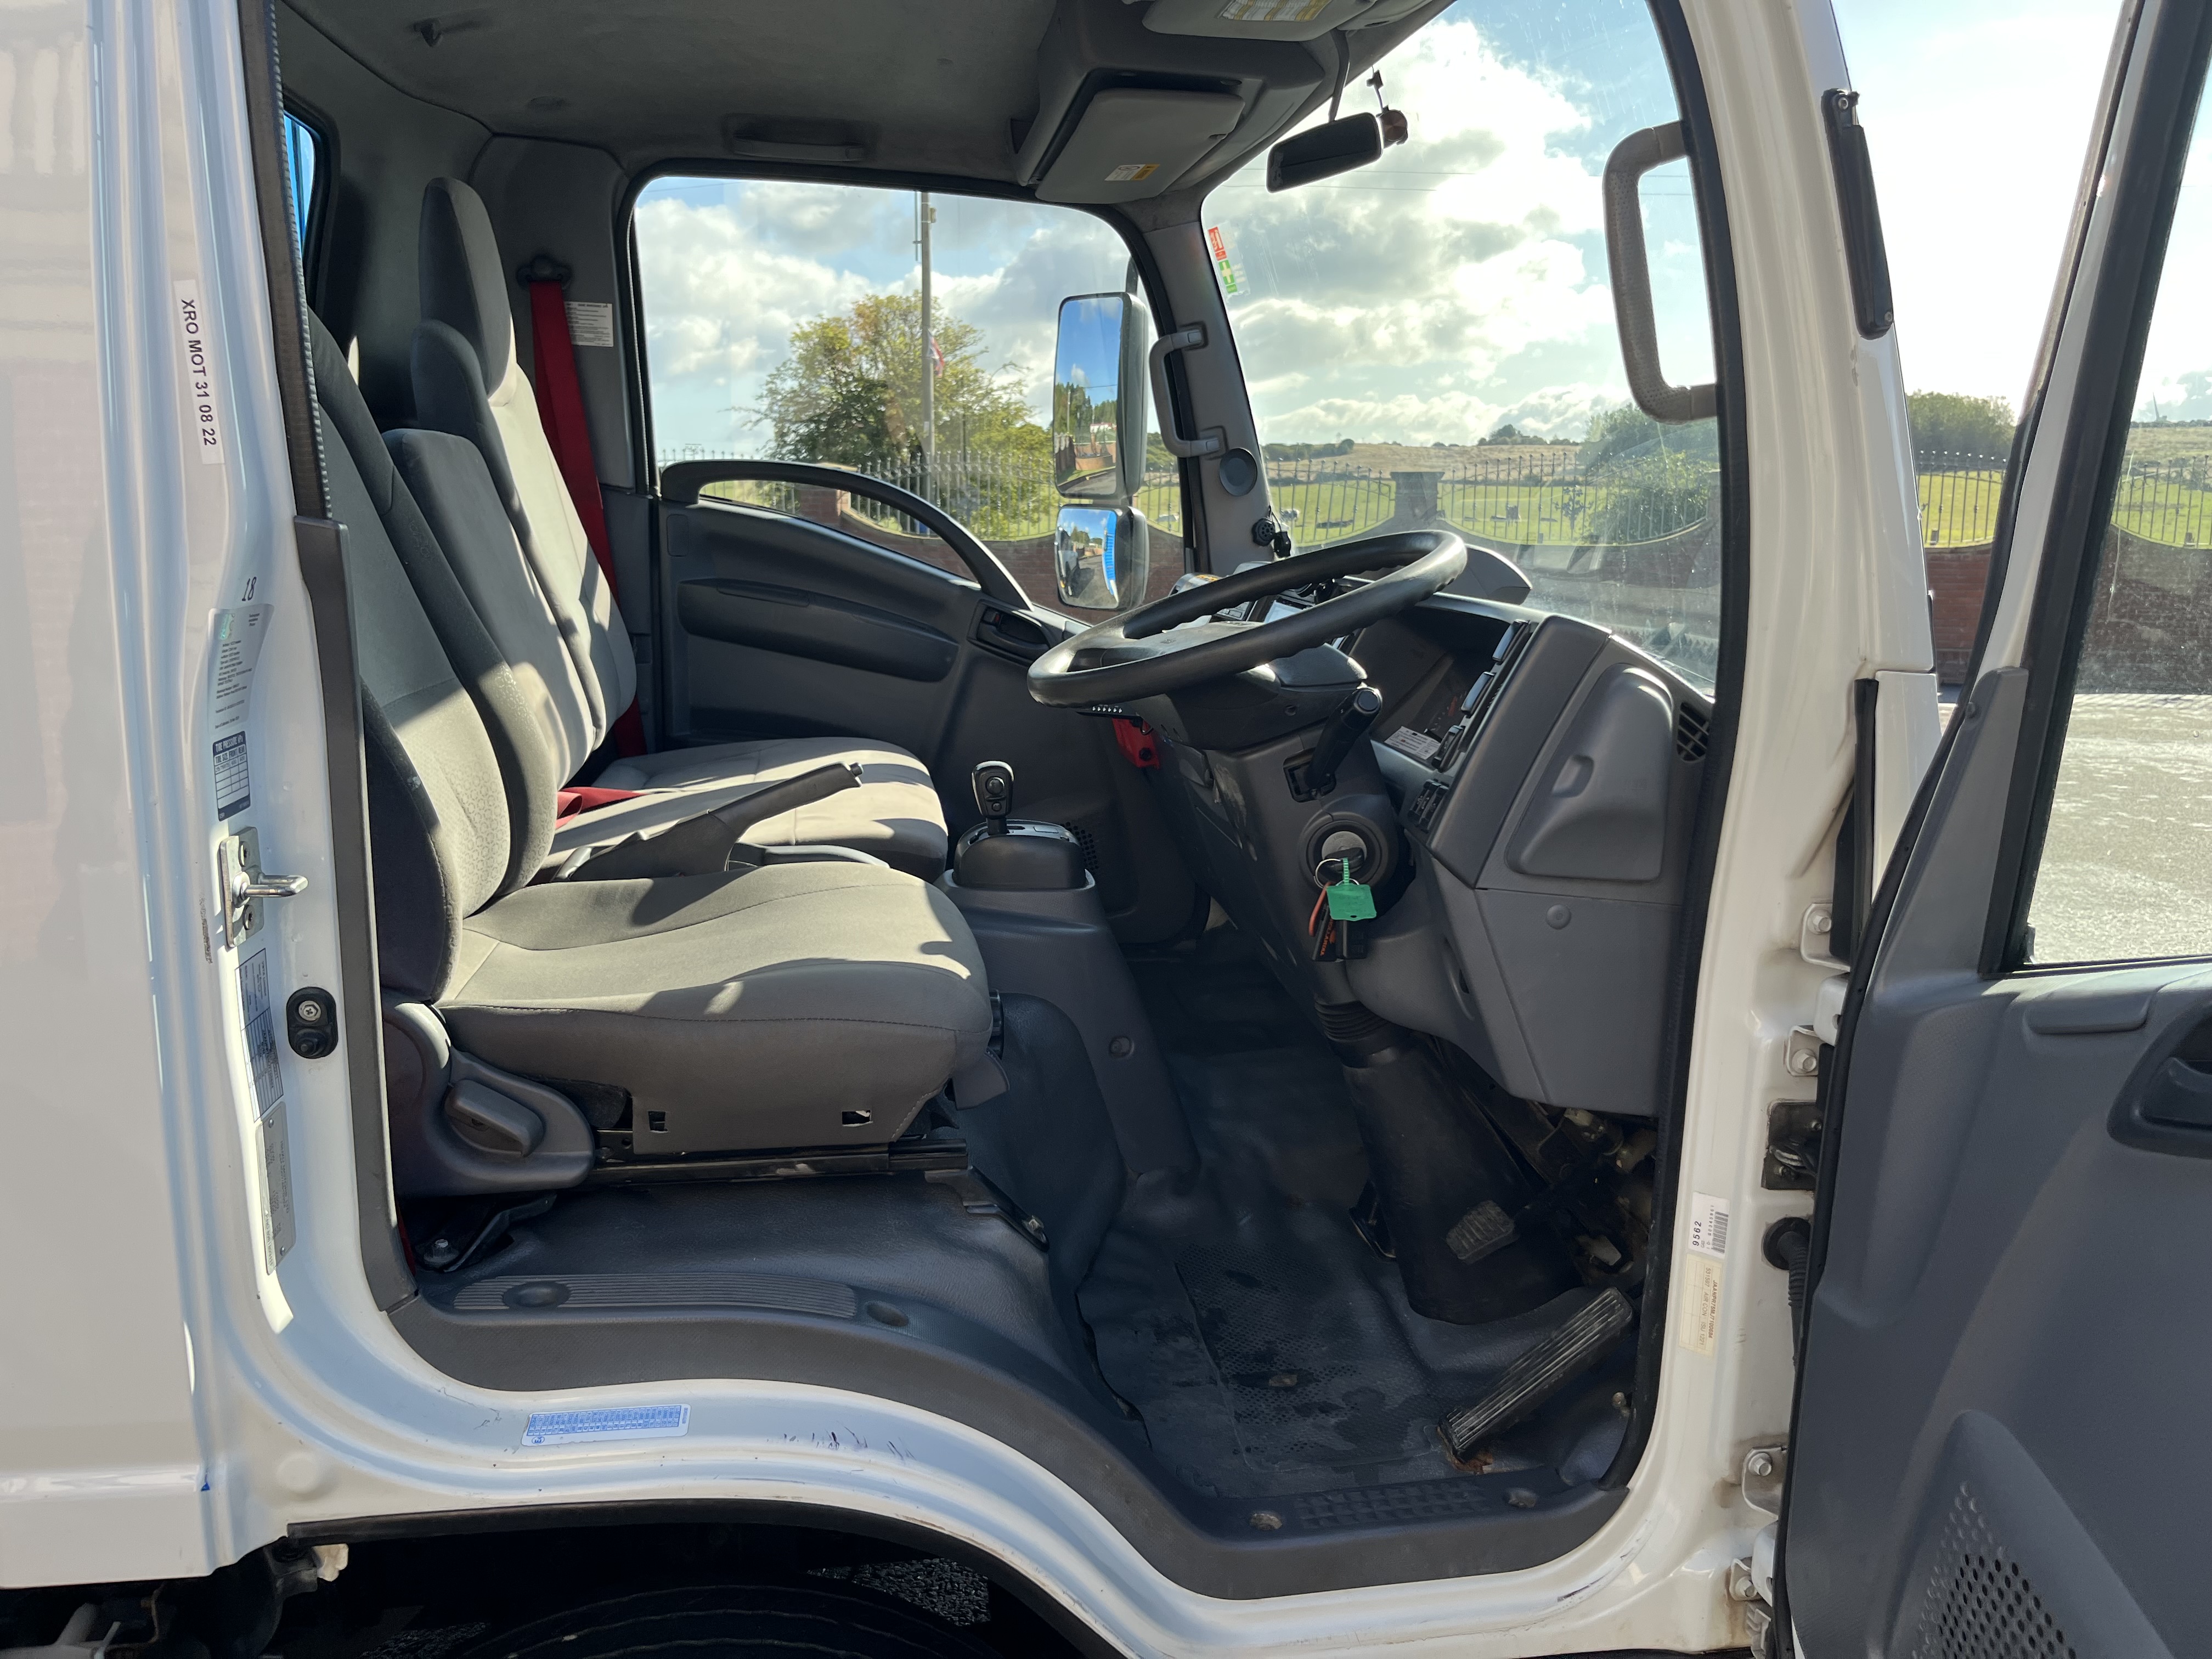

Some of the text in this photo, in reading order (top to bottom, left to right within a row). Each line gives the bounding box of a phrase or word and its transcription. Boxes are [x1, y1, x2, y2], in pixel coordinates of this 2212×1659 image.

[181, 299, 217, 445] XRO MOT 31 08 22
[1692, 1221, 1701, 1246] 9562
